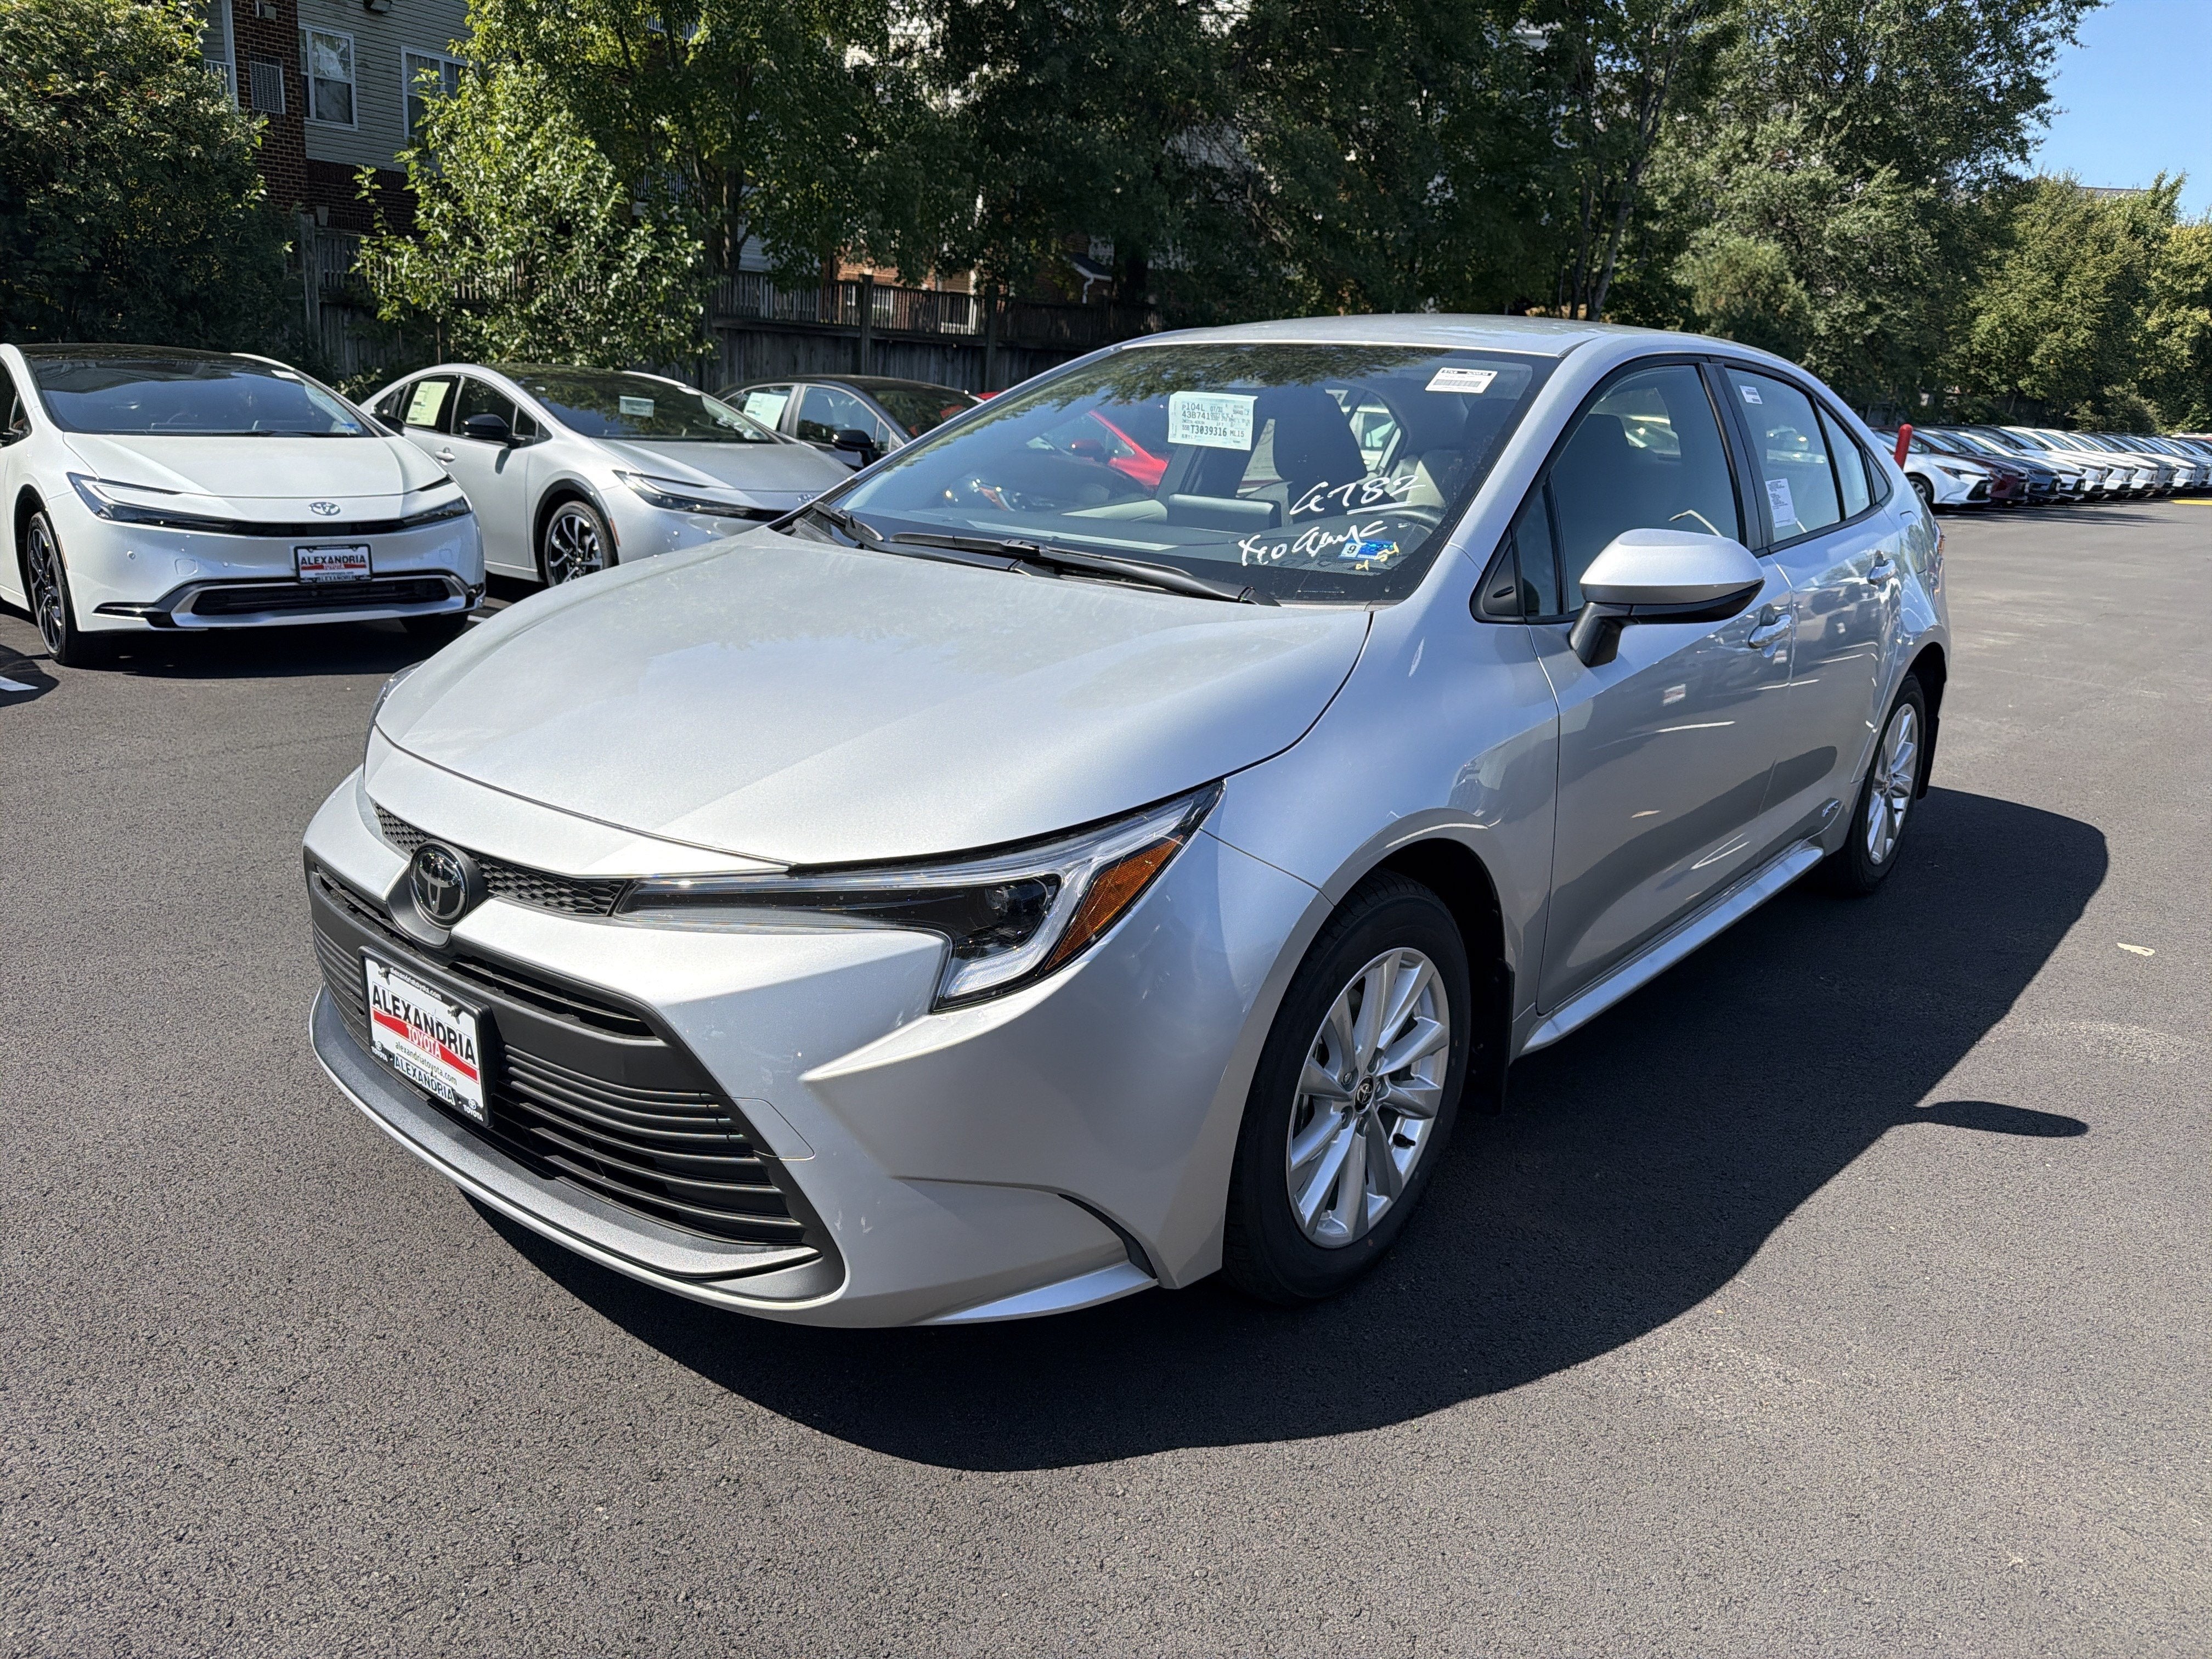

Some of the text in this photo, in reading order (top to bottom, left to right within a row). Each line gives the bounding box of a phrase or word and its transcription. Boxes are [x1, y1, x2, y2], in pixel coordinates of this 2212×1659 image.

[1190, 425, 1227, 437] T3039316
[1346, 545, 1357, 554] 9
[301, 555, 366, 565] ALEXANDRIA
[372, 984, 477, 1065] ALEXANDRIA
[407, 1024, 442, 1059] TOYOTA
[371, 1046, 388, 1062] TOYOTA
[395, 1041, 458, 1086] alexandriatoyota.com
[394, 1054, 456, 1105] ALEXANDRIA
[463, 1104, 483, 1121] TOYOTA
